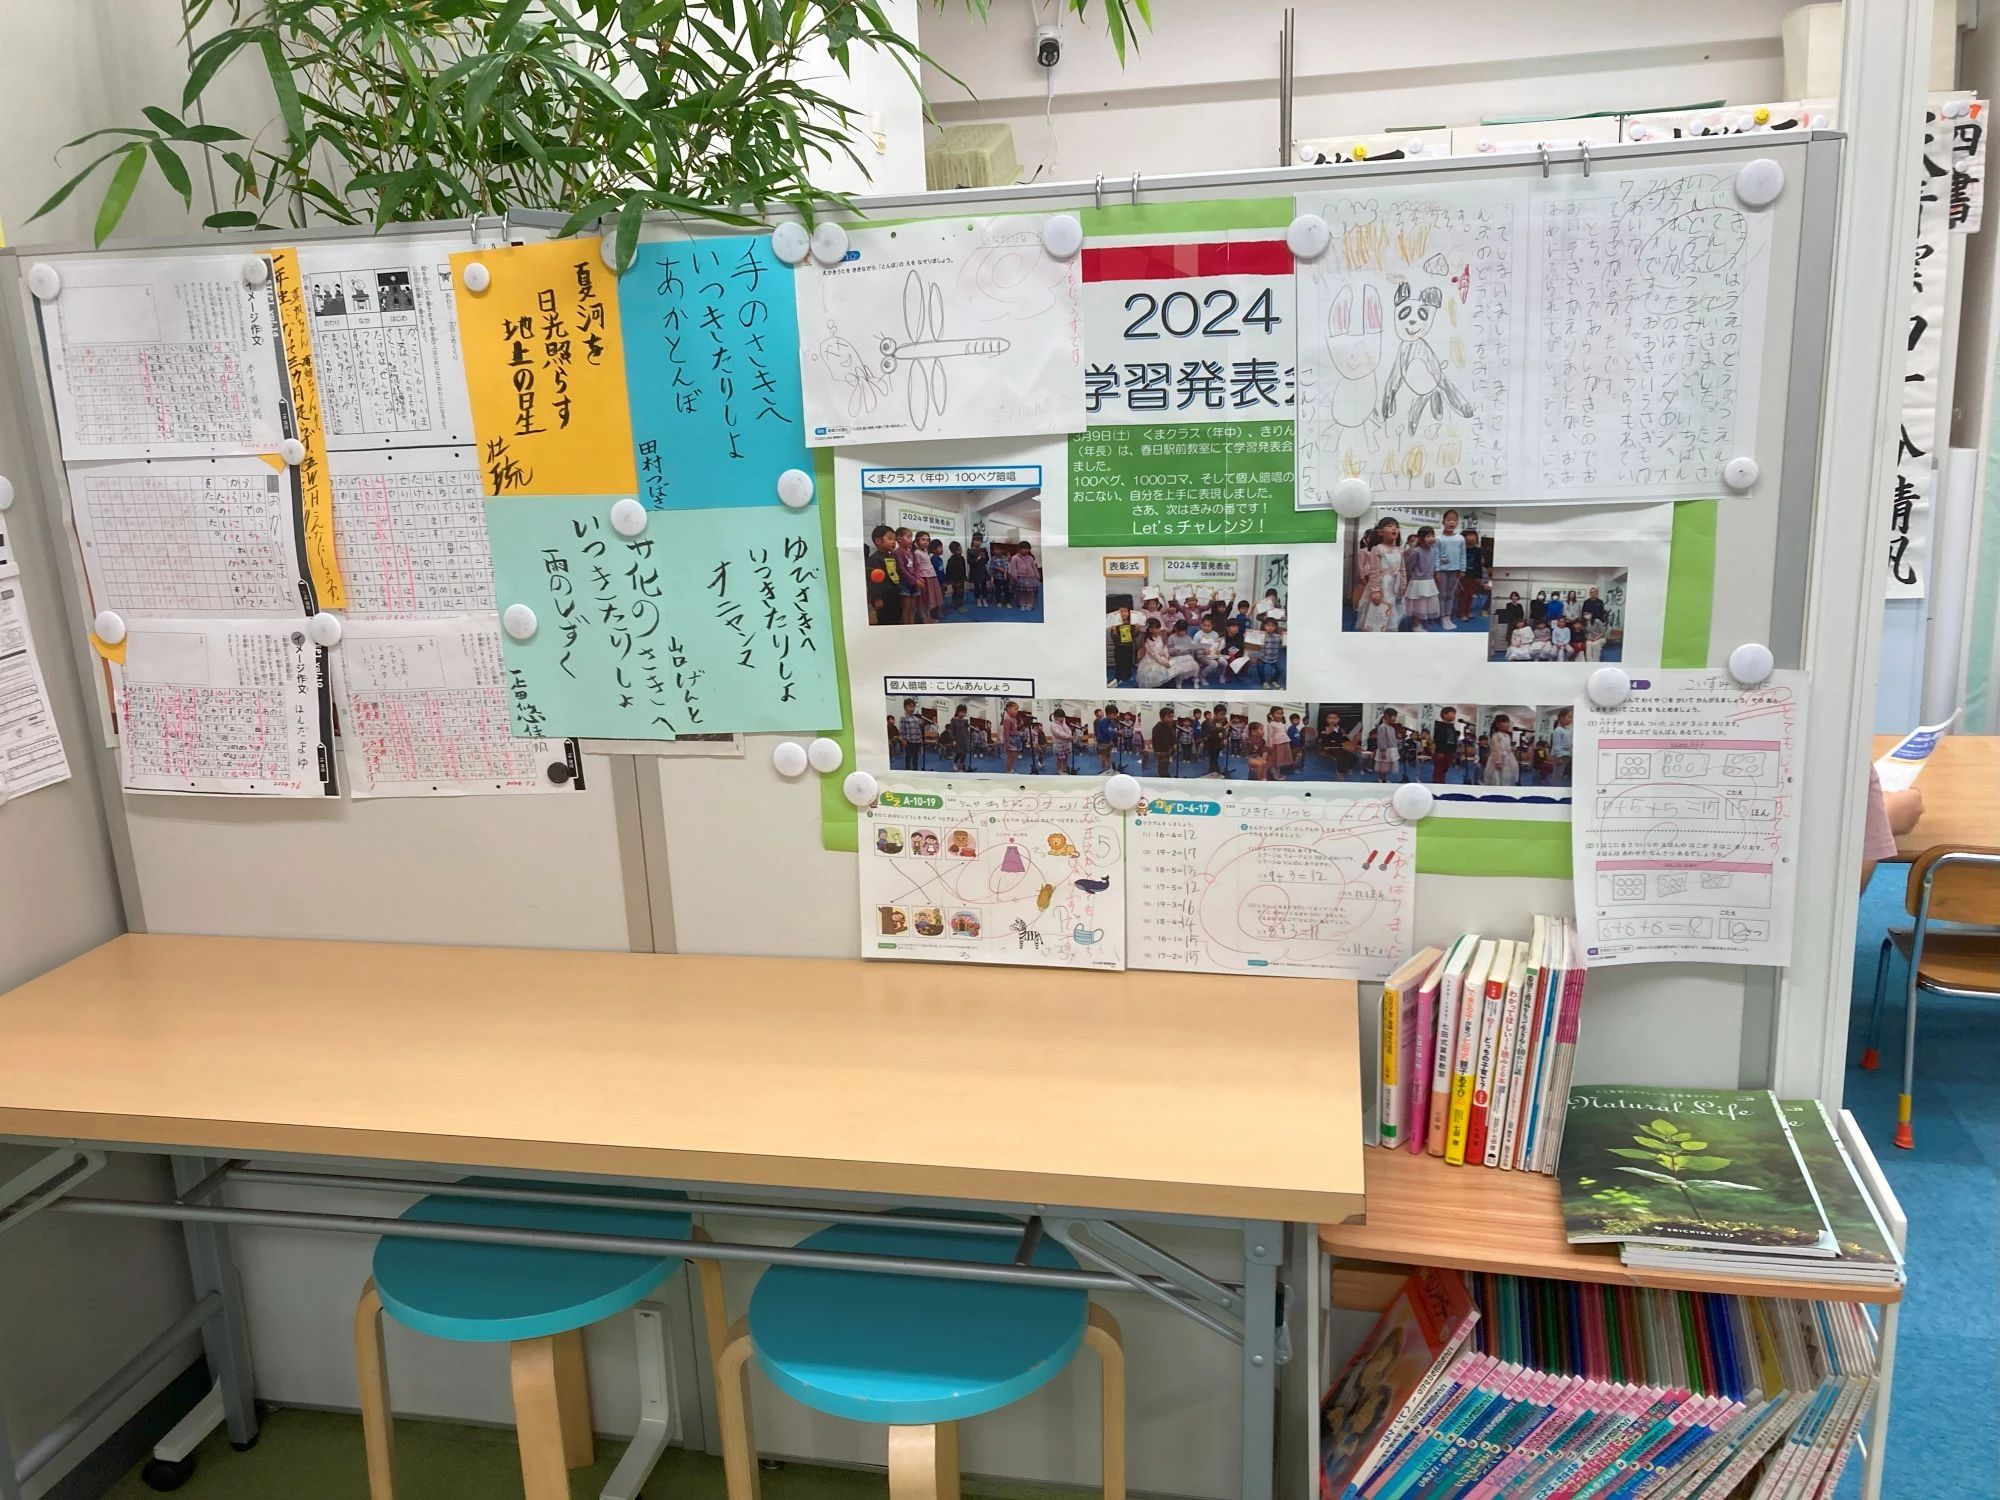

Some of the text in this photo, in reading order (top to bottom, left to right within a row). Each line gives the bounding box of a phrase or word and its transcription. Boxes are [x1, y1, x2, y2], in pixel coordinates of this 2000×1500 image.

[573, 261, 605, 366] 夏河を
[655, 257, 703, 415] あかとんぼ
[730, 238, 793, 425] 手のさきへ
[1123, 287, 1282, 341] 2024
[538, 289, 573, 430] 日光照らす
[1085, 357, 1295, 413] 学習発表
[1073, 461, 1112, 473] ました。
[782, 536, 820, 653] ゆびさきへ
[1109, 560, 1140, 571] 表彰式
[541, 548, 592, 680] 雨のしずく
[290, 631, 310, 694] イメージ作文
[903, 796, 937, 808] A-10-19
[1176, 802, 1210, 815] D-4-17
[1567, 1094, 1756, 1122] Natural Life
